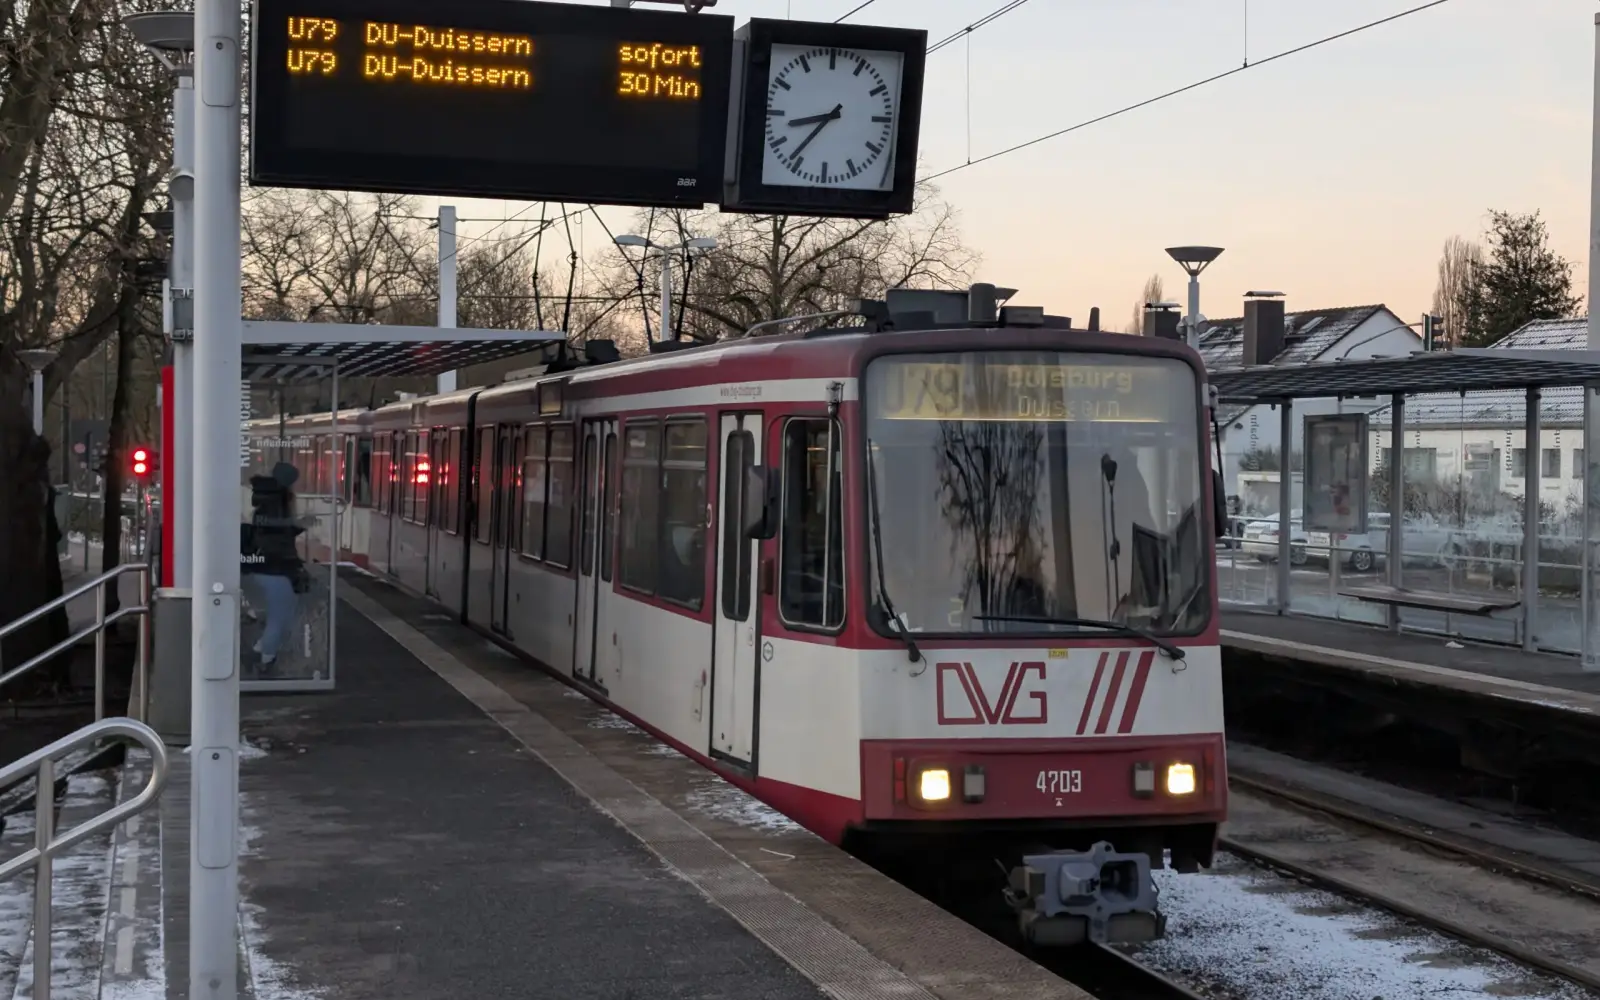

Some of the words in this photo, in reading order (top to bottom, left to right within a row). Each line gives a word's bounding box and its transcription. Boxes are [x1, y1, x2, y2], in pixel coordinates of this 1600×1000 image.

[287, 16, 337, 40] U79
[366, 22, 531, 54] DU-Duissern
[619, 43, 700, 69] sofort
[287, 48, 335, 73] U79
[364, 54, 530, 86] DU-Duissern
[619, 72, 649, 93] 30
[655, 74, 699, 97] Min
[936, 661, 1048, 726] DVG
[1036, 770, 1082, 793] 4703
